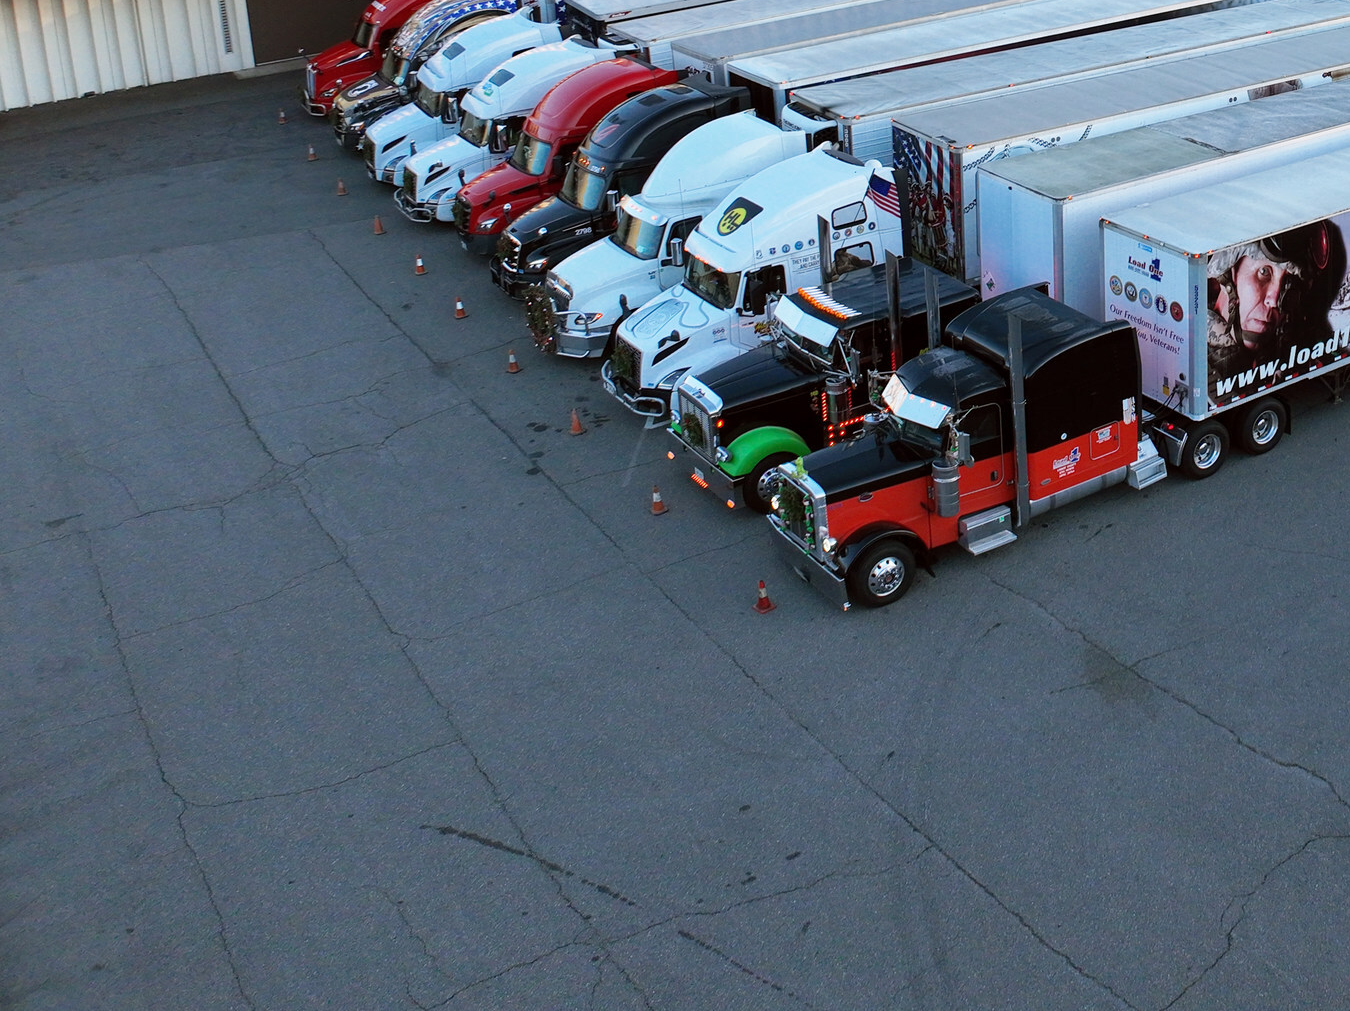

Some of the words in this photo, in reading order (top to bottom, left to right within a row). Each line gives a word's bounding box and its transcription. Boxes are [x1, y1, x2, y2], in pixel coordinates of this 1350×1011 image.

[575, 227, 592, 236] 2798
[1128, 256, 1146, 269] Load
[1110, 304, 1122, 316] Our
[1124, 310, 1152, 330] Freedom
[1153, 323, 1169, 337] Isn't
[1169, 332, 1184, 345] Free
[1149, 334, 1181, 355] Veterans!
